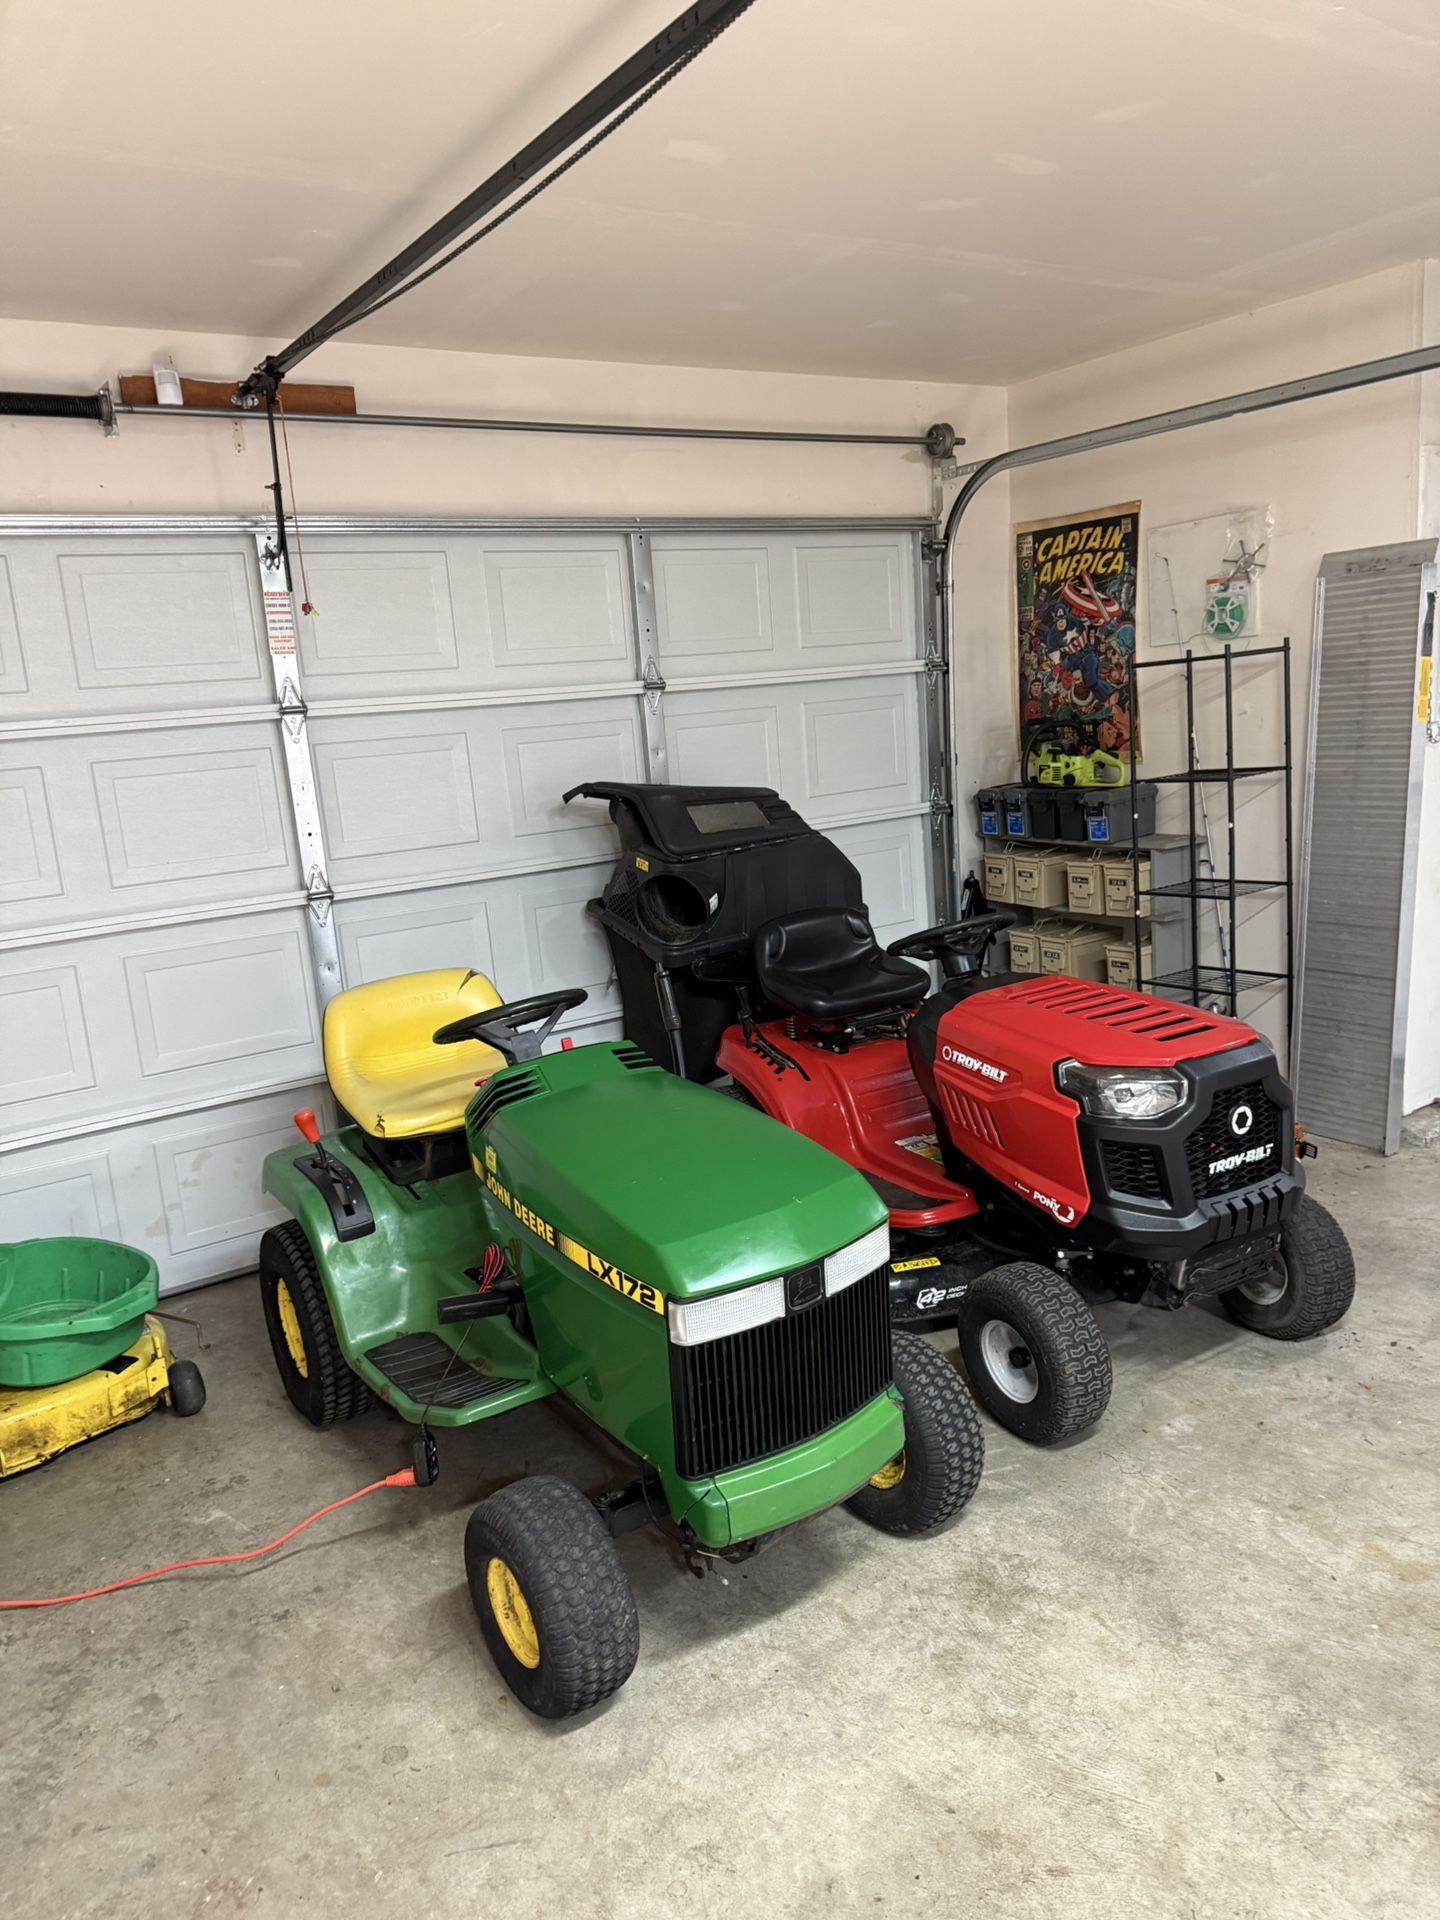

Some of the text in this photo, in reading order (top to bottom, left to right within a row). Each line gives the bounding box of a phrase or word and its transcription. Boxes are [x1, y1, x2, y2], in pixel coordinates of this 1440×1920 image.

[1037, 526, 1123, 563] CAPTAIN
[1039, 551, 1125, 584] AMERICA
[952, 1050, 1009, 1083] TROY-BILT
[1208, 1142, 1274, 1176] TROY-BILT
[486, 1172, 555, 1247] JOHN DEERE
[1033, 1190, 1061, 1212] PONY
[587, 1251, 656, 1310] LX172
[920, 1284, 968, 1304] 42 INCH
